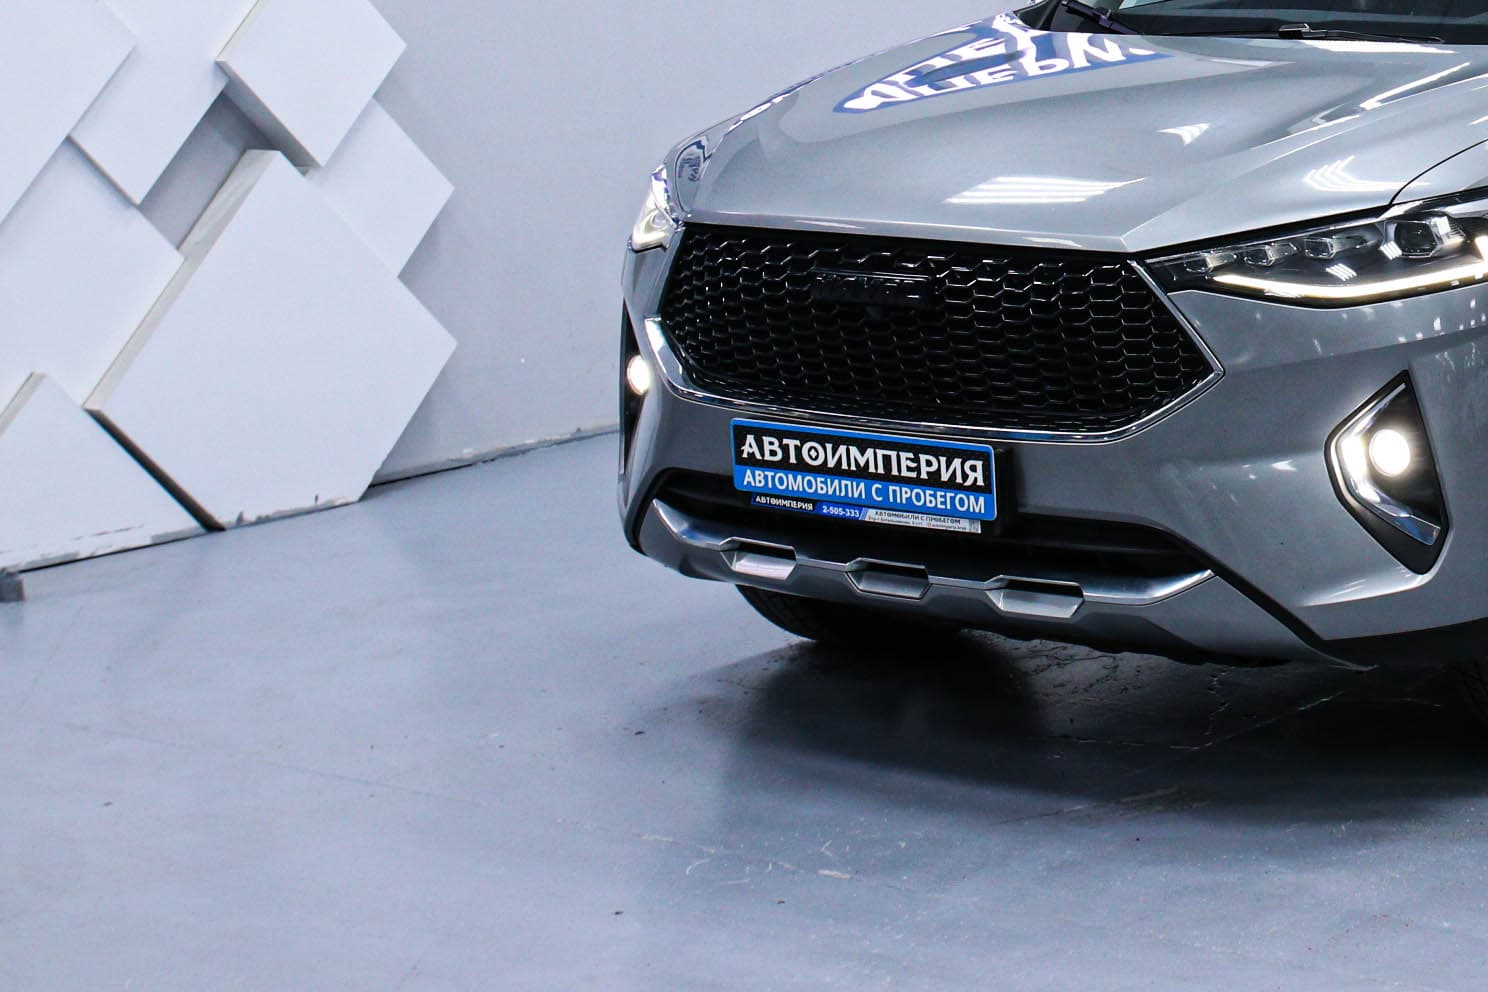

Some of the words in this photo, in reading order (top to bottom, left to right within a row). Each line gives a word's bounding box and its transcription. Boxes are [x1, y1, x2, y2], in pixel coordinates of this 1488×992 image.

[741, 434, 985, 486] АВТОИМПЕРИЯ
[743, 469, 866, 499] АВТОМОБИЛИ
[871, 484, 884, 502] С
[889, 486, 985, 514] ПРОБЕГОМ
[755, 495, 814, 511] АВТОИМПЕРИЯ
